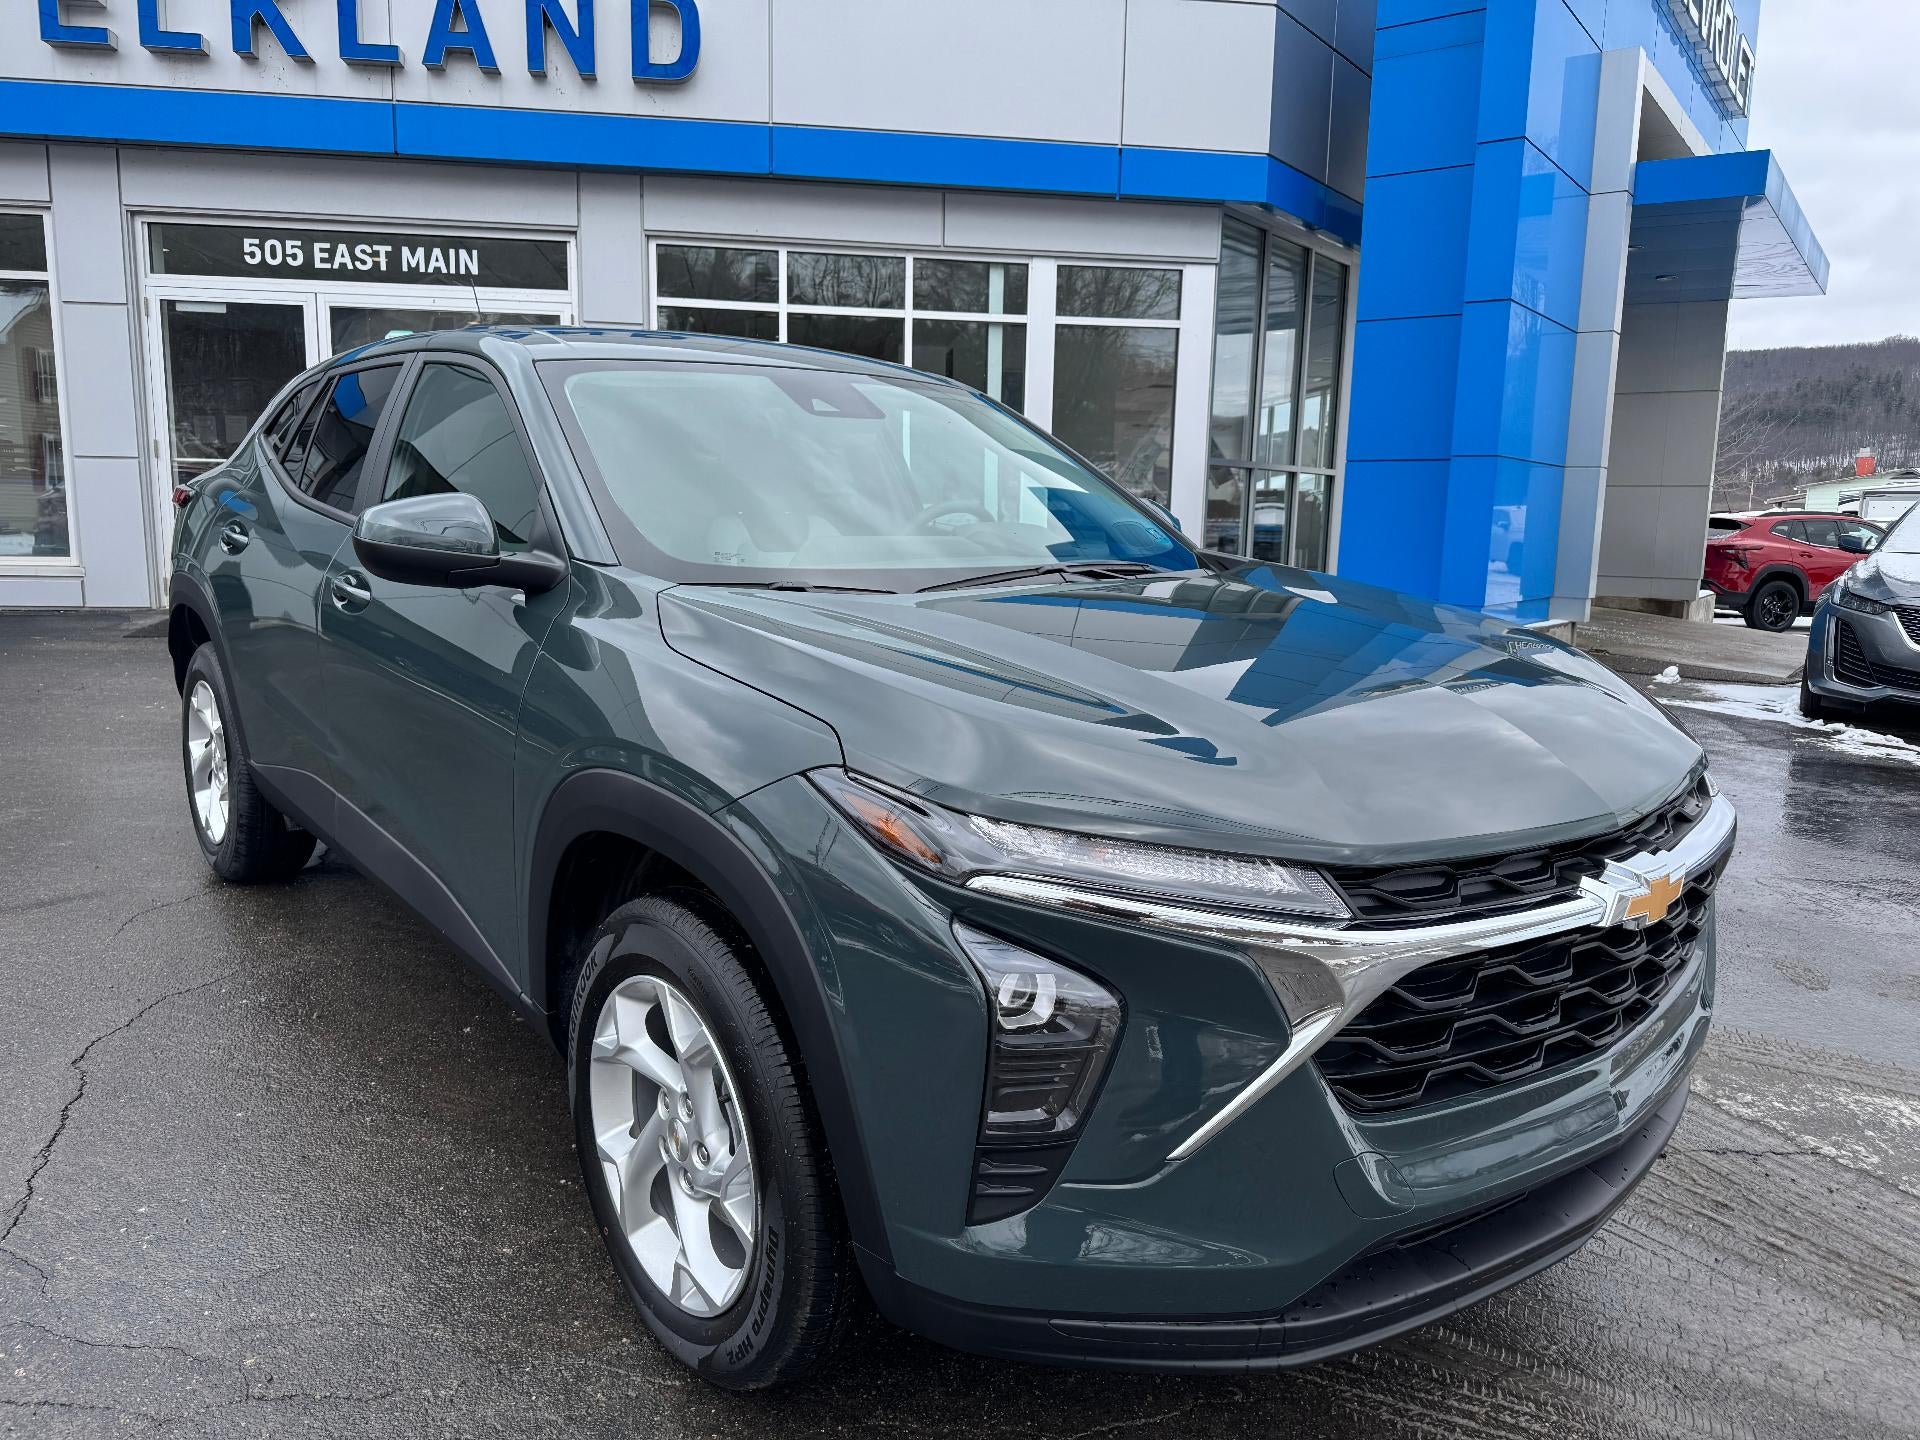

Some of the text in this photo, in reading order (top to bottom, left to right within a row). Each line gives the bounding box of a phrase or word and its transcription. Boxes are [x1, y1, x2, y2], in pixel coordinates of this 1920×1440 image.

[243, 238, 479, 275] 505 EAST MAIN
